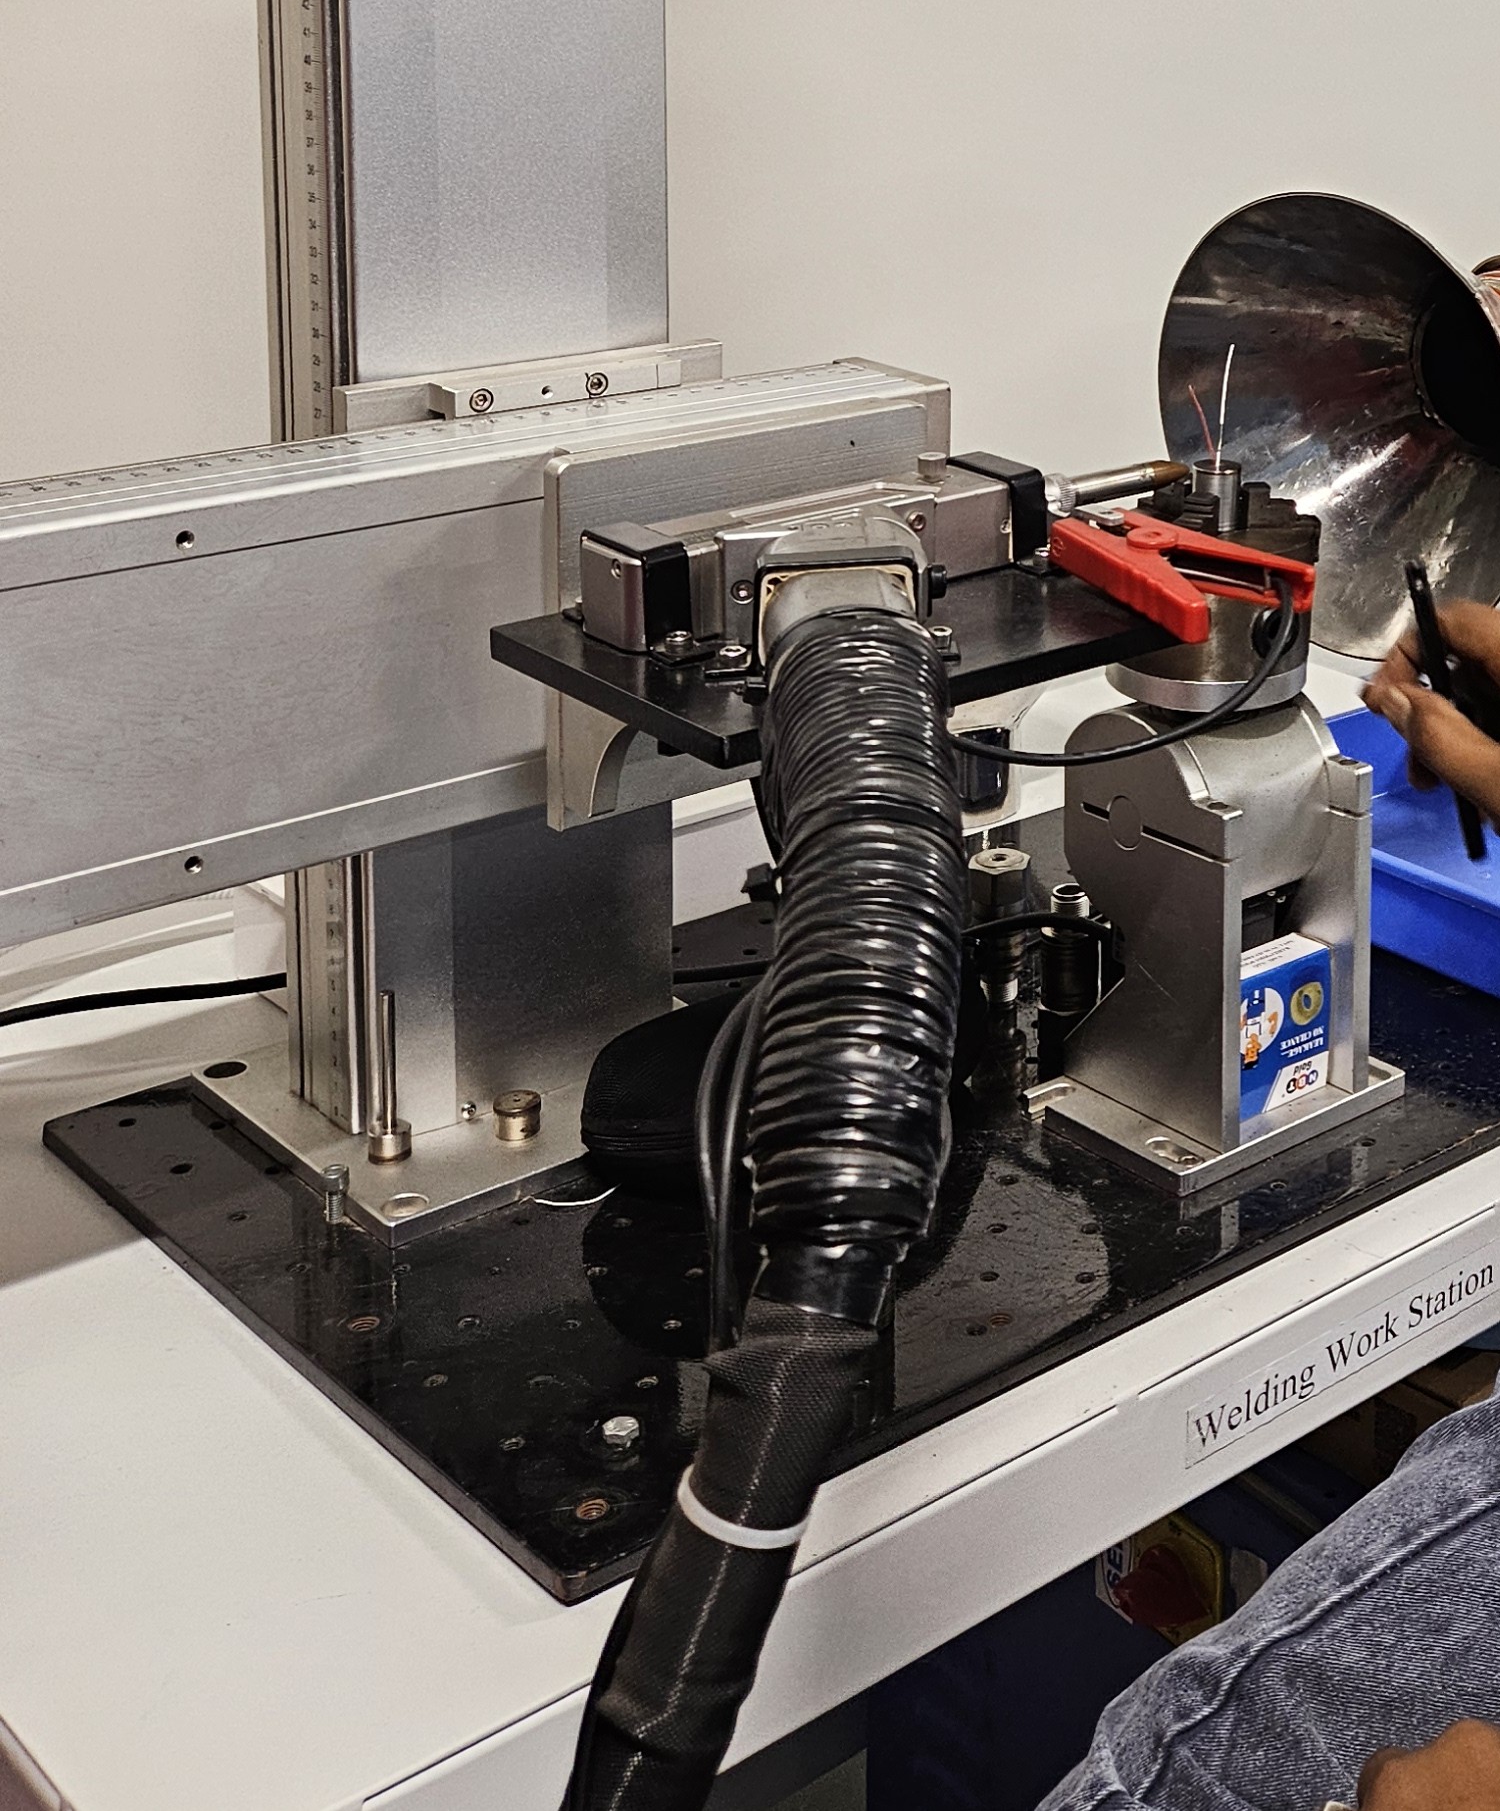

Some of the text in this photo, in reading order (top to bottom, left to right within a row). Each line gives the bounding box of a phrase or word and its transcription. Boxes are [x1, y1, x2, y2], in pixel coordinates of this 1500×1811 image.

[1195, 1262, 1495, 1447] Welding Work Station
